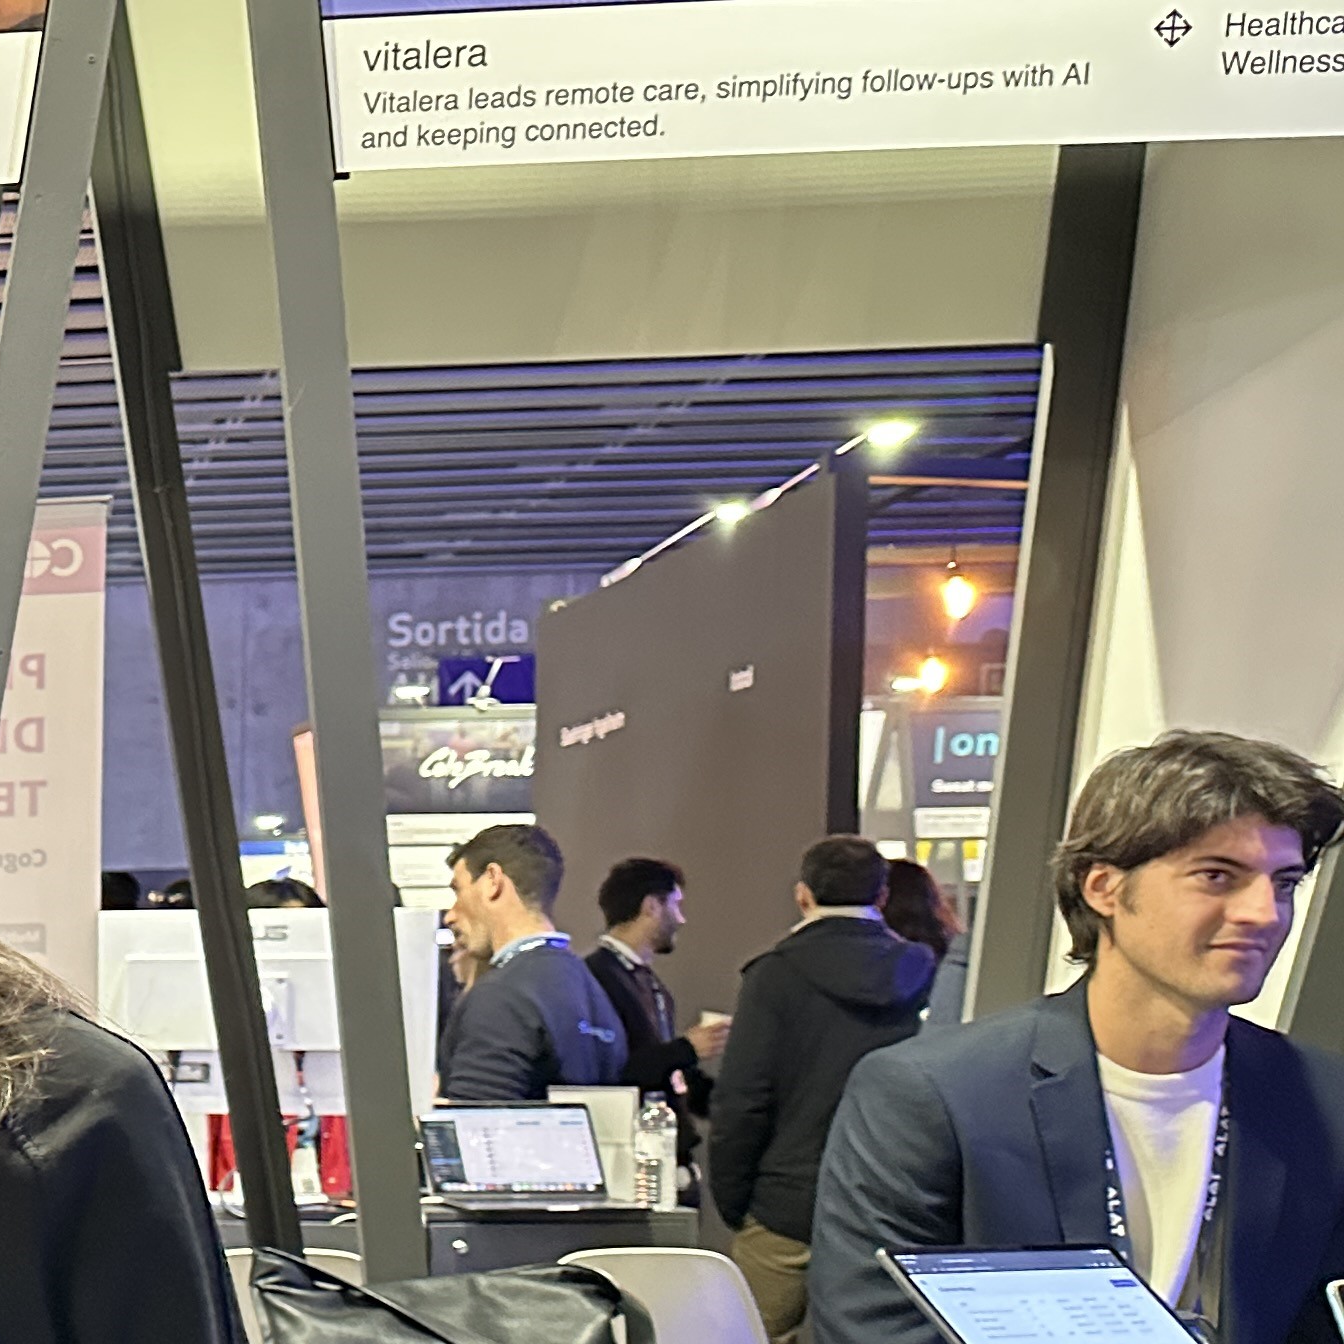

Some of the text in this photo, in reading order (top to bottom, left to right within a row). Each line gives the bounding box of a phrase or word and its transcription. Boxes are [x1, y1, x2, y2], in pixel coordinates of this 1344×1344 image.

[1225, 11, 1344, 38] Healthca
[363, 39, 488, 72] vitalera
[363, 62, 1091, 115] Vitalera leads remote care, simplifying follow-ups with AI
[361, 114, 665, 150] and keeping connected.
[388, 610, 529, 648] Sortida
